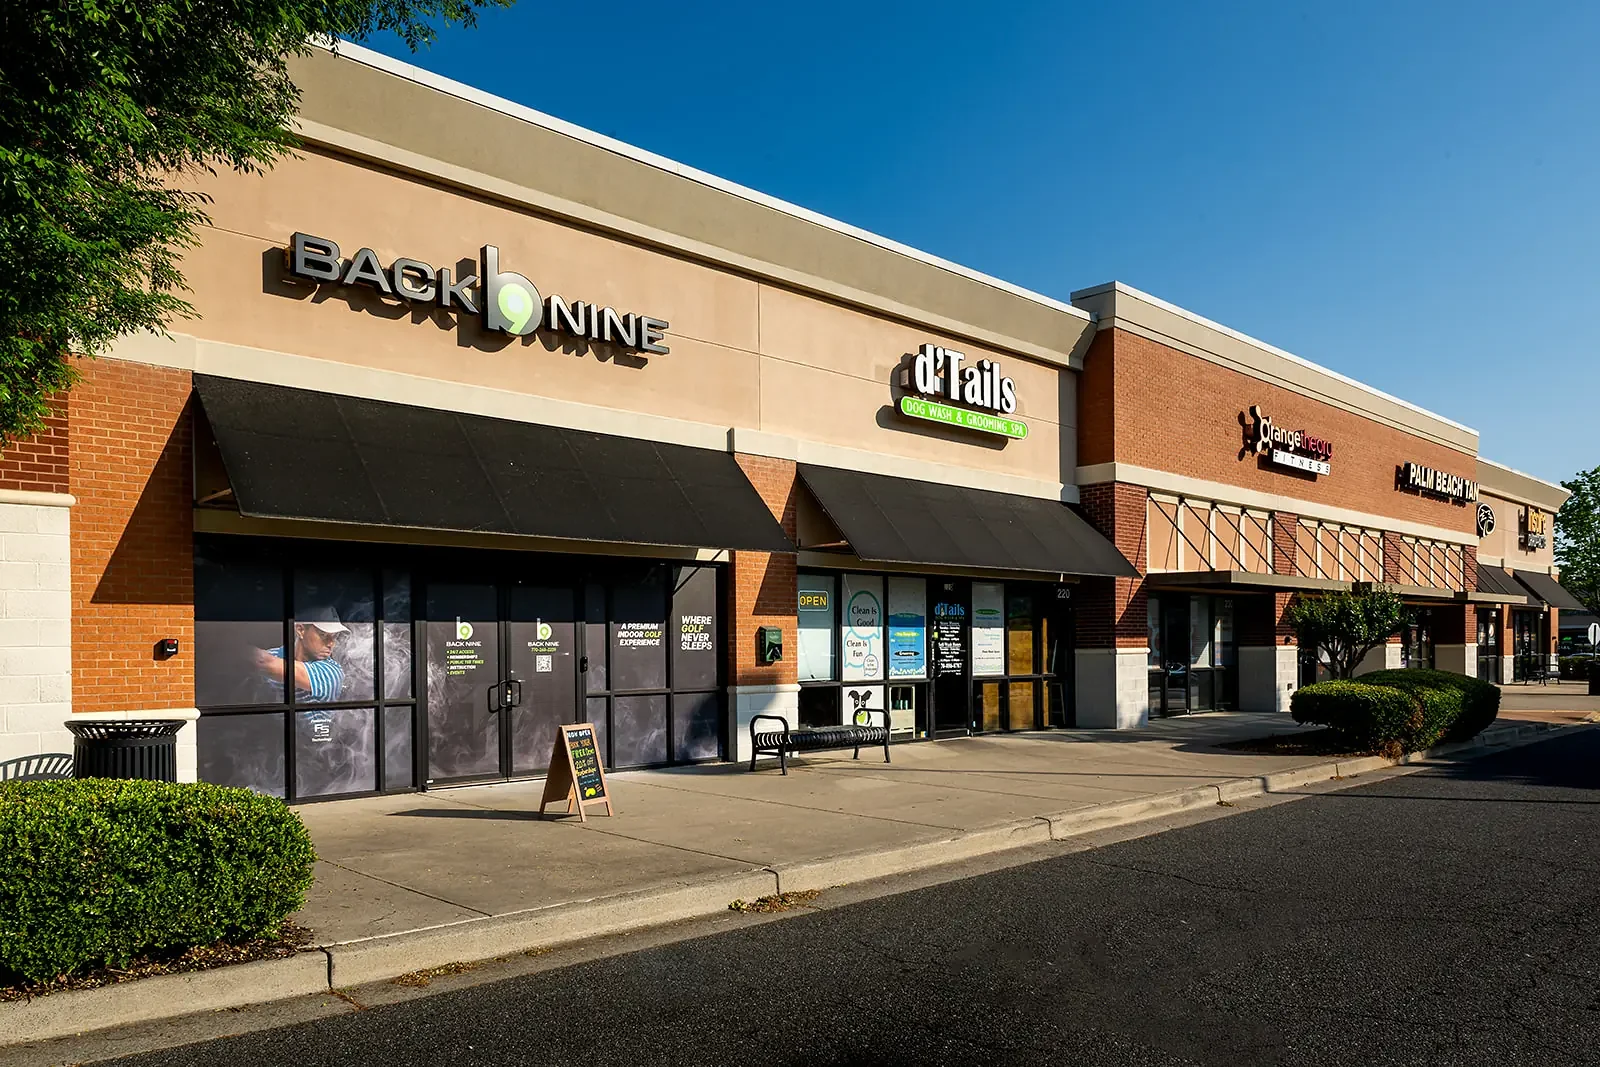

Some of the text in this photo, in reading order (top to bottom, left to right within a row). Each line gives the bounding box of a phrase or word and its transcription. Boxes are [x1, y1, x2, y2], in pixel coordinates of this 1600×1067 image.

[291, 232, 479, 314] BACK
[545, 294, 669, 356] NINE
[907, 400, 1024, 436] DOG WASH & GROOMING SPA
[1274, 451, 1330, 474] FITNESS
[1409, 463, 1480, 502] PALM BEACH TAN
[1057, 588, 1071, 599] 220
[799, 595, 827, 606] OPEN
[851, 606, 878, 615] Clean Is
[681, 616, 712, 625] WHERE
[857, 618, 875, 627] Good
[681, 624, 704, 633] GOLF
[681, 633, 710, 642] NEVER
[681, 641, 713, 651] SLEEPS
[846, 640, 861, 648] Clean
[314, 723, 330, 734] FS
